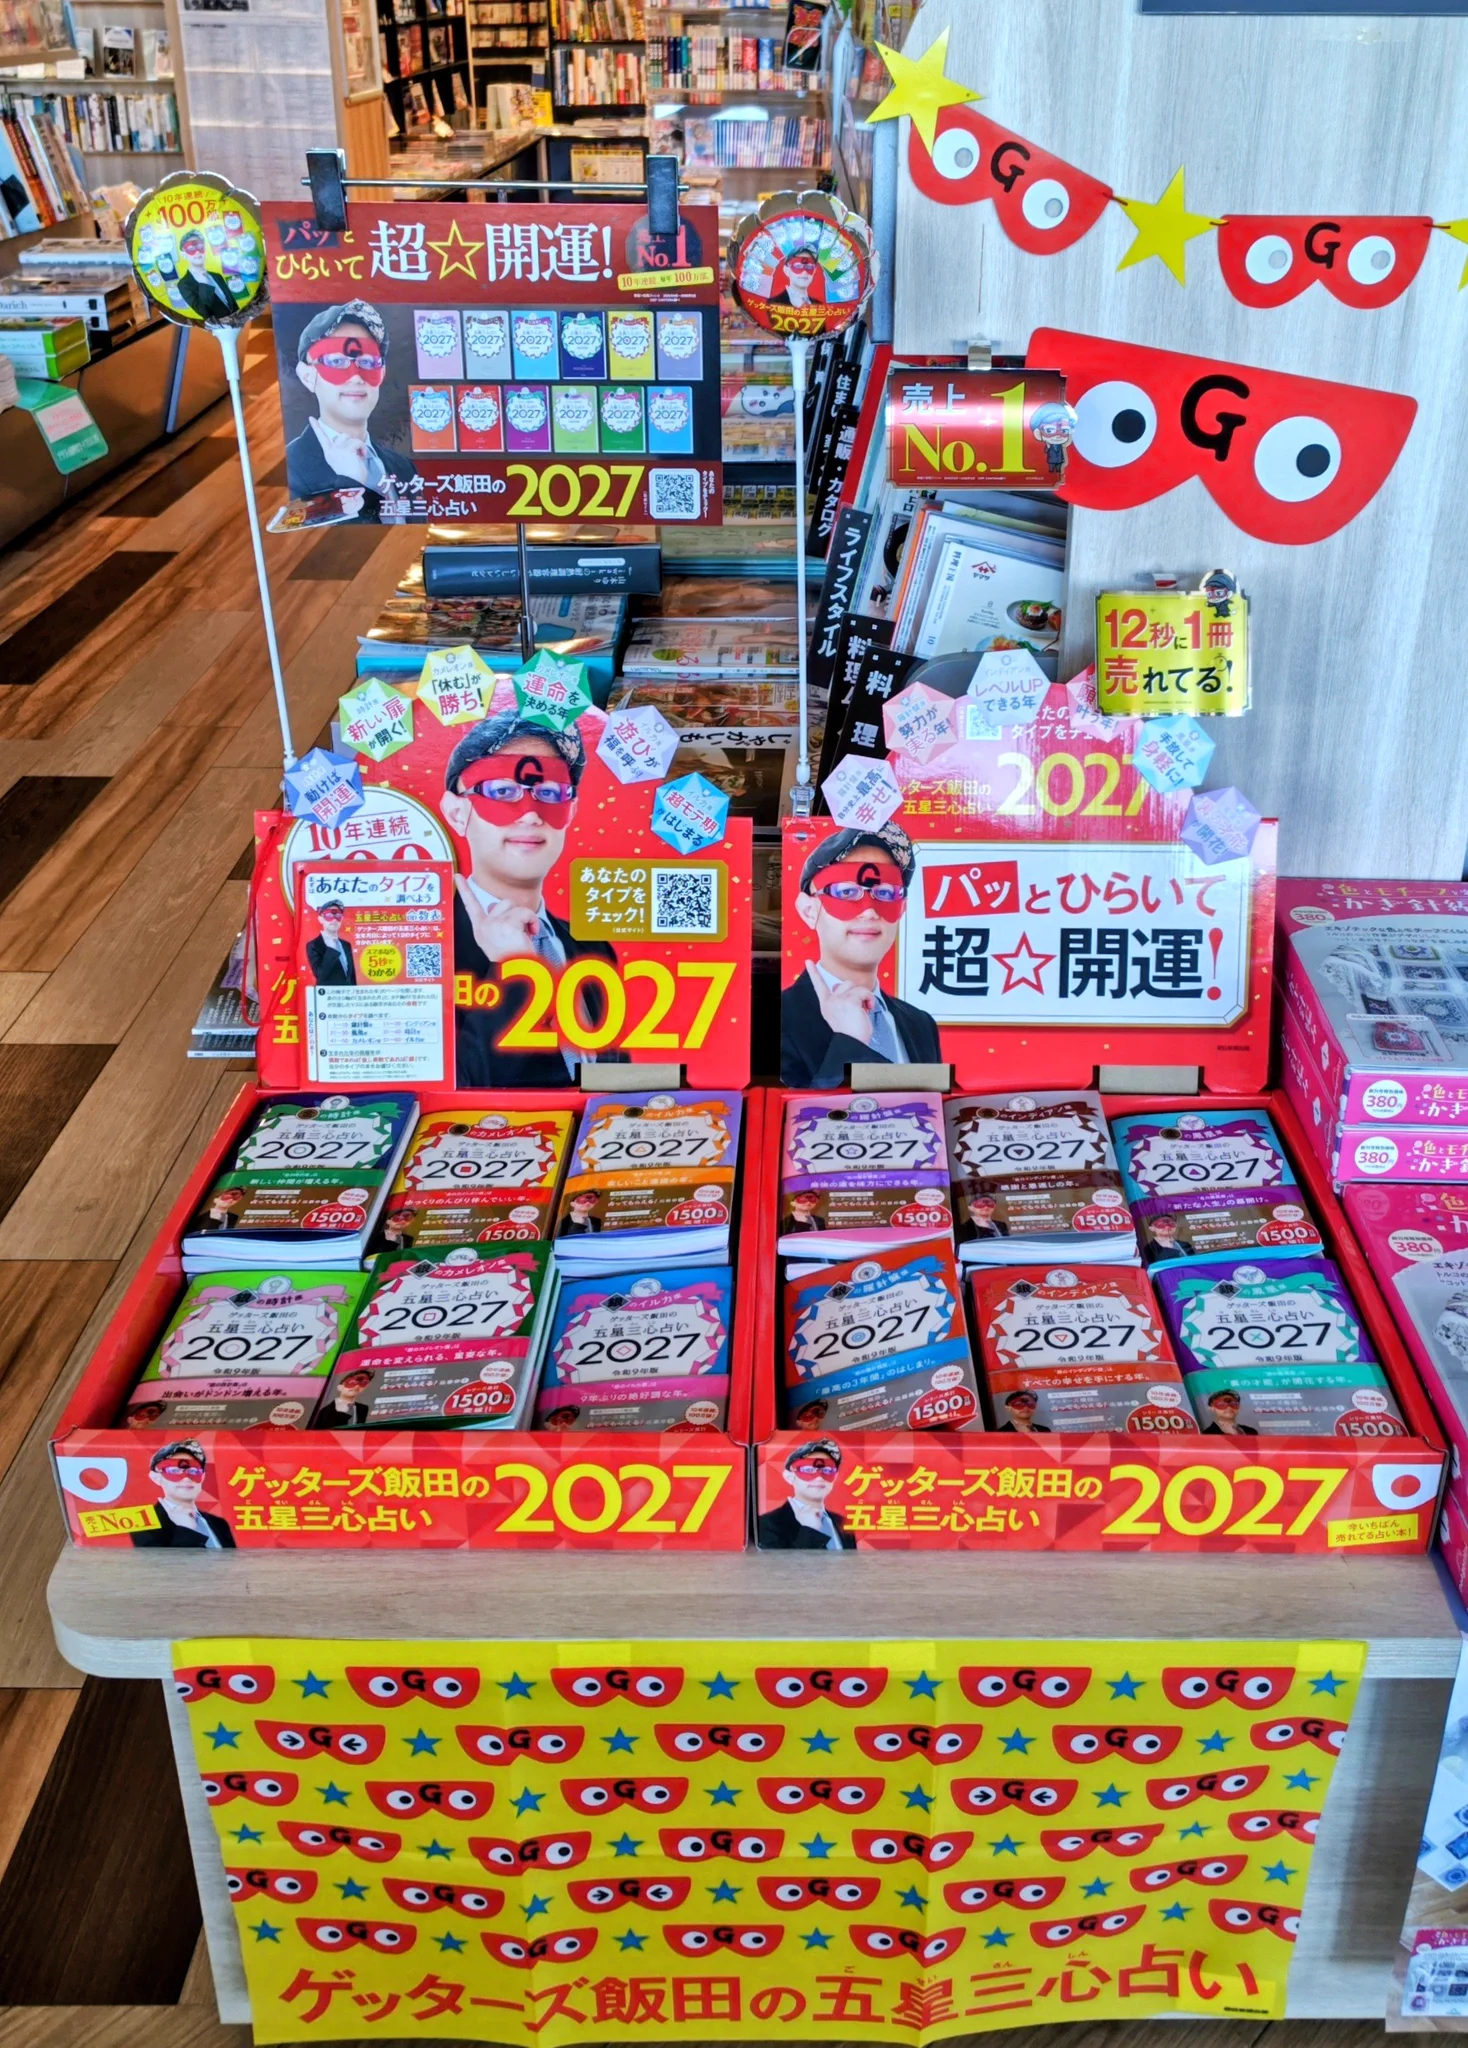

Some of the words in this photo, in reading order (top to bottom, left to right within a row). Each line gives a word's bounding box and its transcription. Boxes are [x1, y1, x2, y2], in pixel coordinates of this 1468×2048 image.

[637, 225, 691, 267] No.1
[276, 253, 364, 280] ひらいて
[771, 315, 826, 334] 2027
[423, 335, 452, 344] 2027
[472, 334, 500, 344] 2027
[520, 336, 549, 344] 2027
[568, 336, 596, 345] 2027
[616, 336, 645, 345] 2027
[664, 336, 692, 344] 2027
[902, 382, 966, 415] 売上
[417, 409, 445, 418] 2027
[465, 409, 493, 418] 2027
[512, 410, 540, 419] 2027
[560, 410, 588, 419] 2027
[608, 410, 636, 419] 2027
[655, 410, 683, 419] 2027
[899, 382, 1036, 472] No.1
[378, 474, 506, 495] ゲッターズ飯田の
[506, 464, 644, 517] 2027
[379, 500, 477, 516] 五星三心占い
[817, 526, 861, 658] ライフスタイル
[1103, 608, 1234, 651] 12秒に1冊
[1105, 655, 1233, 696] 売れてる!
[523, 673, 581, 706] 運命を
[975, 678, 1043, 697] レベルUP
[438, 688, 484, 716] 勝ち!
[525, 696, 568, 721] 決める年
[850, 670, 894, 749] 料理
[984, 695, 1036, 712] できる年
[347, 696, 406, 741] 新しい扉
[899, 704, 938, 740] 努力が
[368, 720, 407, 750] が開く!
[614, 717, 661, 769] 遊びが
[906, 717, 954, 755] 実る年!
[1160, 732, 1194, 770] 手放して
[1142, 741, 1184, 787] 身軽に!
[304, 769, 341, 804] 動けば
[995, 752, 1150, 817] 2027
[312, 779, 360, 822] 開運!
[903, 800, 993, 815] 五星三心占い
[305, 816, 412, 854] 10年連続
[655, 807, 702, 847] がはじまる
[316, 876, 435, 894] あなたのタイプを
[580, 868, 647, 884] あなたの
[396, 894, 431, 903] 調べよう
[585, 888, 646, 904] タイプを
[931, 867, 1227, 917] パッとひらいて
[585, 906, 644, 924] チェック!
[498, 959, 738, 1050] 2027
[277, 1131, 363, 1139] 五星三心占い
[614, 1130, 699, 1139] 五星三心占い
[823, 1132, 907, 1141] 五星三心占い
[987, 1131, 1072, 1142] 五星三心占い
[254, 1141, 370, 1160] 2027
[442, 1150, 526, 1159] 五星三心占い
[599, 1138, 709, 1160] 2027
[811, 1140, 918, 1160] 2027
[978, 1140, 1085, 1163] 2027
[1160, 1151, 1246, 1161] 五星三心占い
[423, 1159, 535, 1179] 2027
[1152, 1158, 1259, 1182] 2027
[402, 1290, 499, 1304] 五星三心占い
[379, 1301, 509, 1331] 2027
[825, 1298, 917, 1329] 五星三心占い
[1024, 1313, 1121, 1326] 五星三心占い
[1216, 1311, 1314, 1324] 五星三心占い
[206, 1323, 305, 1334] 五星三心占い
[594, 1323, 689, 1338] 五星三心占い
[813, 1306, 930, 1360] 2027
[1014, 1325, 1136, 1352] 2027
[1208, 1323, 1331, 1350] 2027
[180, 1335, 314, 1361] 2027
[576, 1333, 701, 1365] 2027
[1058, 1354, 1104, 1362] 令和9年版
[612, 1367, 659, 1376] 令和9年版
[228, 1466, 489, 1500] ゲッターズ飯田の
[844, 1465, 1103, 1499] ゲッターズ飯田の
[495, 1463, 733, 1534] 2027
[1101, 1464, 1349, 1536] 2027
[86, 1515, 98, 1534] 売上
[100, 1509, 154, 1532] No.1
[233, 1505, 433, 1532] 五星三心占い
[844, 1505, 1040, 1532] 五星三心占い
[1347, 1520, 1400, 1530] 今いちばん
[1335, 1528, 1413, 1542] 売れてる占い本!
[278, 1943, 1260, 2032] ゲッターズ飯田の五星三心占い
